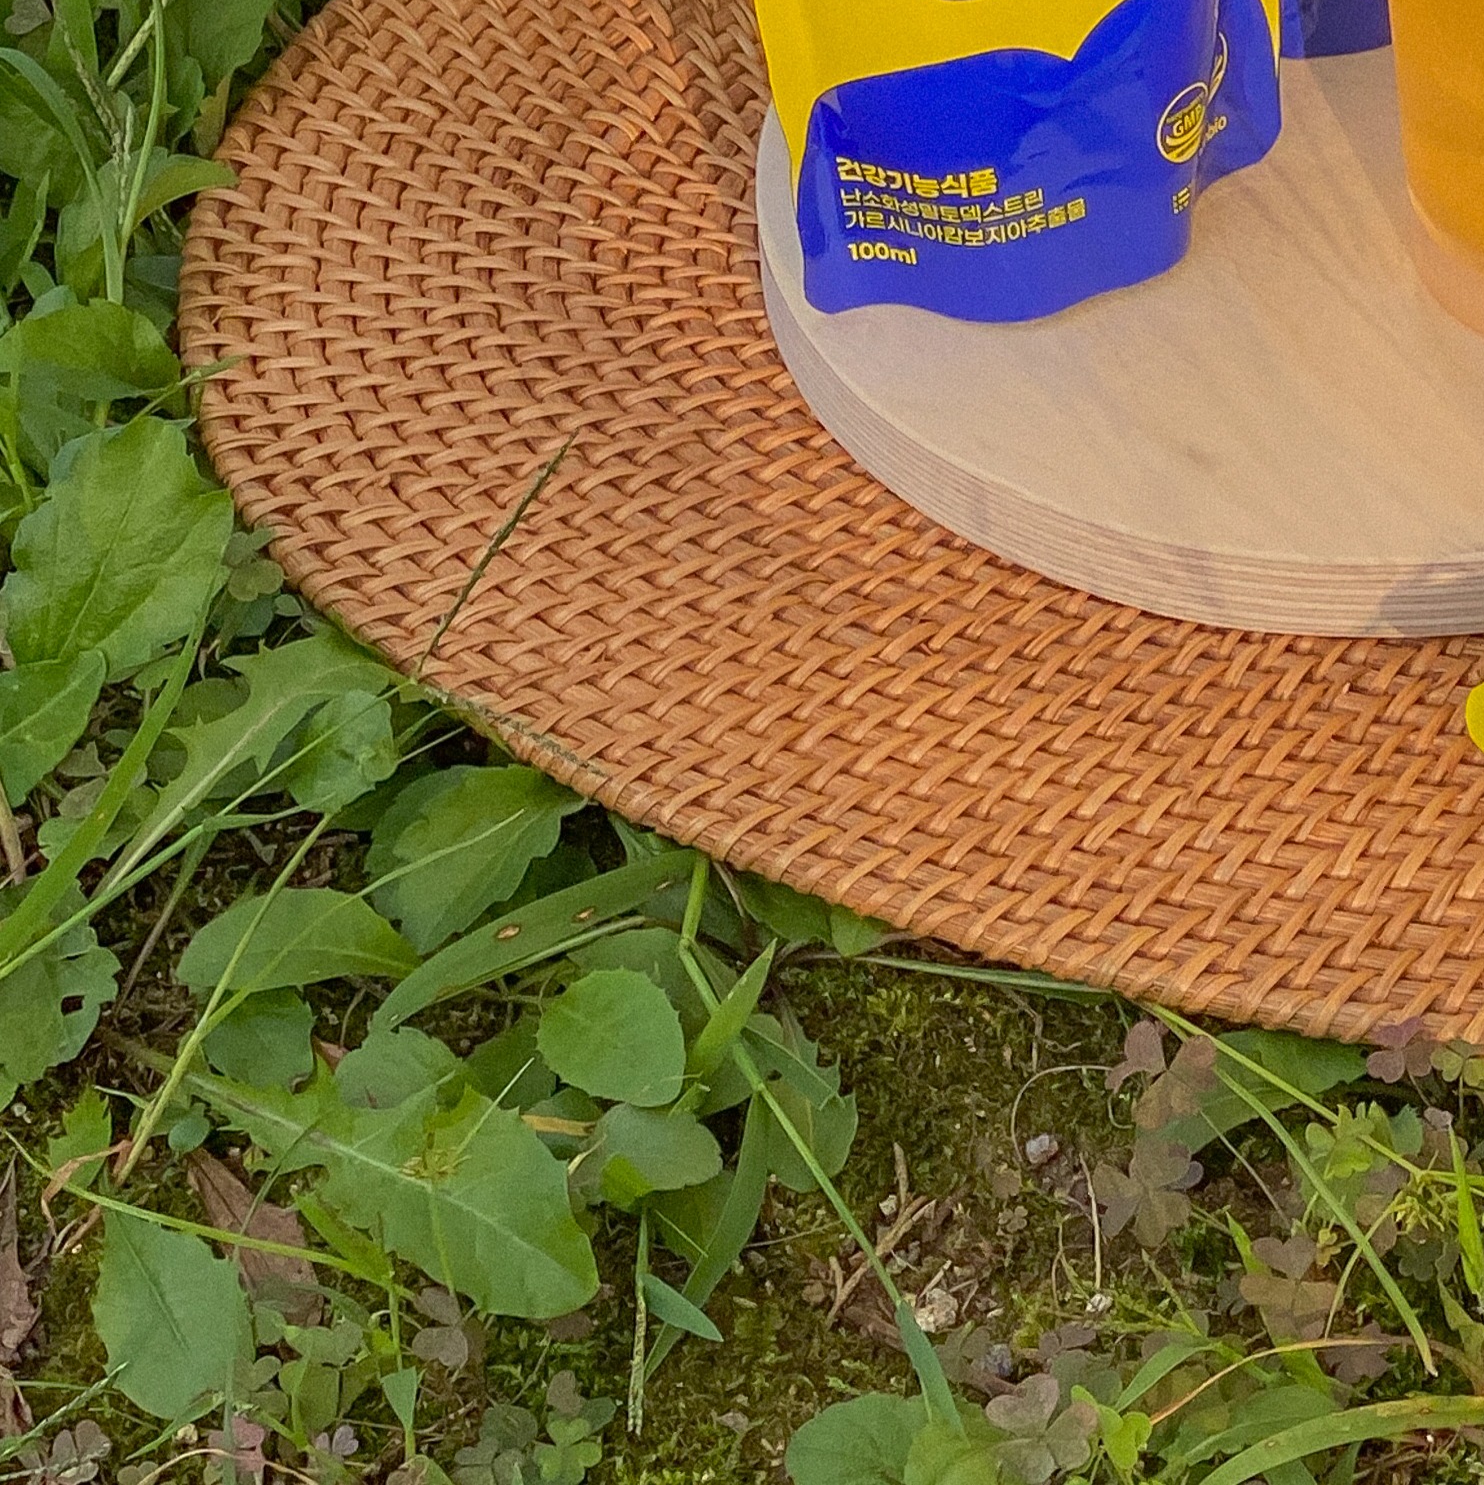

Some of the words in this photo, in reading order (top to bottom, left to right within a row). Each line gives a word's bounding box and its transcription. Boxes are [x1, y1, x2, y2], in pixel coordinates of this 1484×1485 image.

[835, 156, 998, 198] 건강기능식품
[840, 188, 1045, 223] 난소화성말토덱스트린
[847, 242, 918, 265] 100ml
